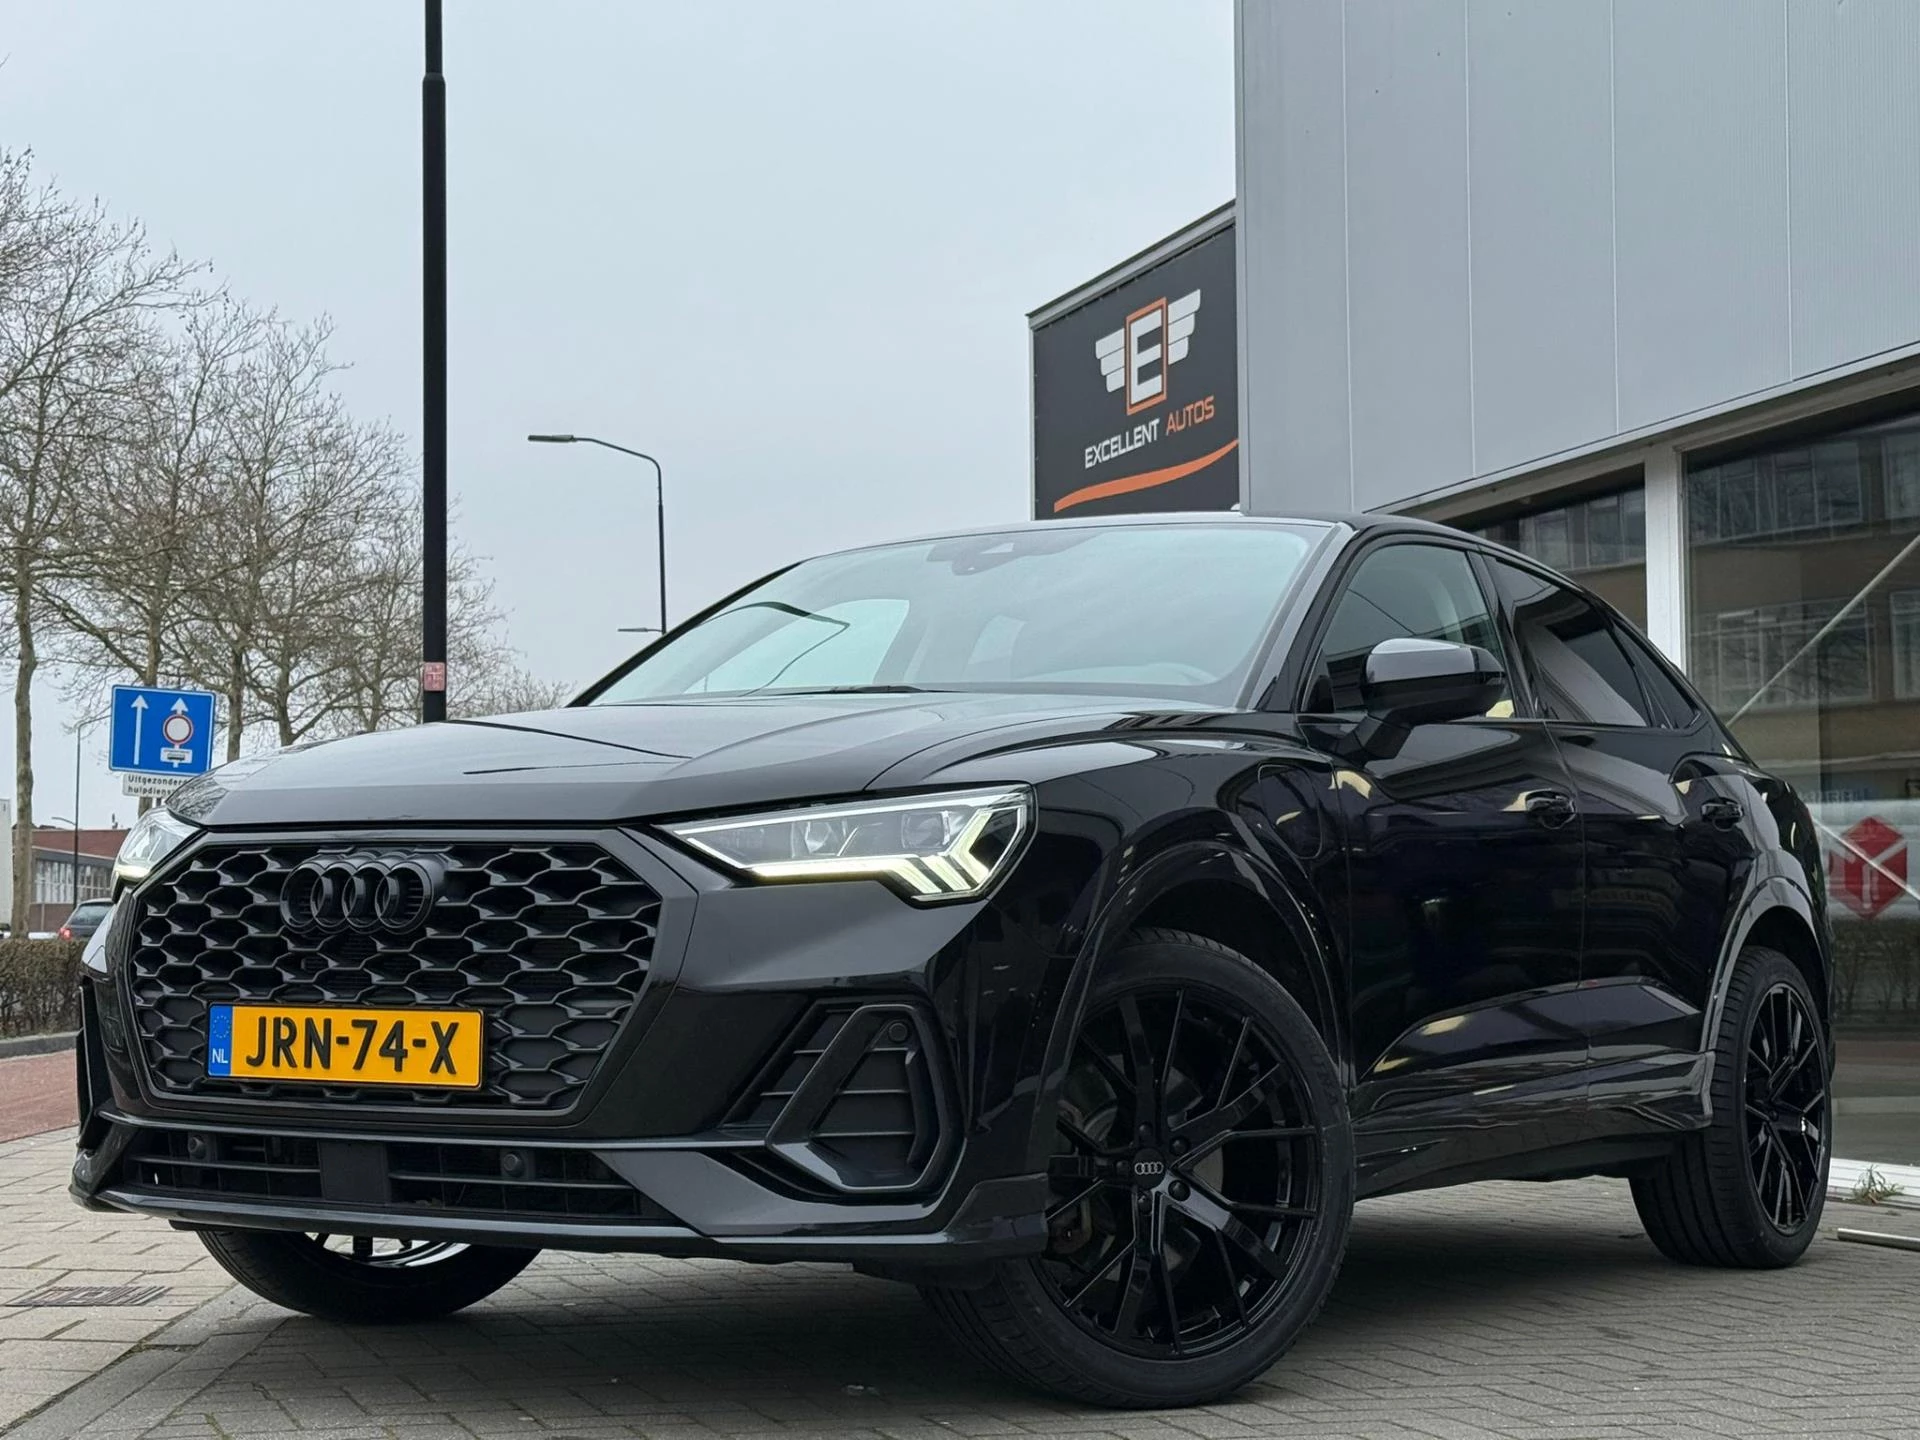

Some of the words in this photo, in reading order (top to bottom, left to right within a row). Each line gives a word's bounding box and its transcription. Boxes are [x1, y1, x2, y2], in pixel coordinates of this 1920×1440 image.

[1130, 308, 1162, 405] E
[1084, 418, 1160, 469] EXCELLENT
[1166, 395, 1215, 436] AUTOS
[128, 785, 175, 795] hulpdiens
[211, 1047, 229, 1064] NL
[246, 1016, 459, 1075] JRN-74-X
